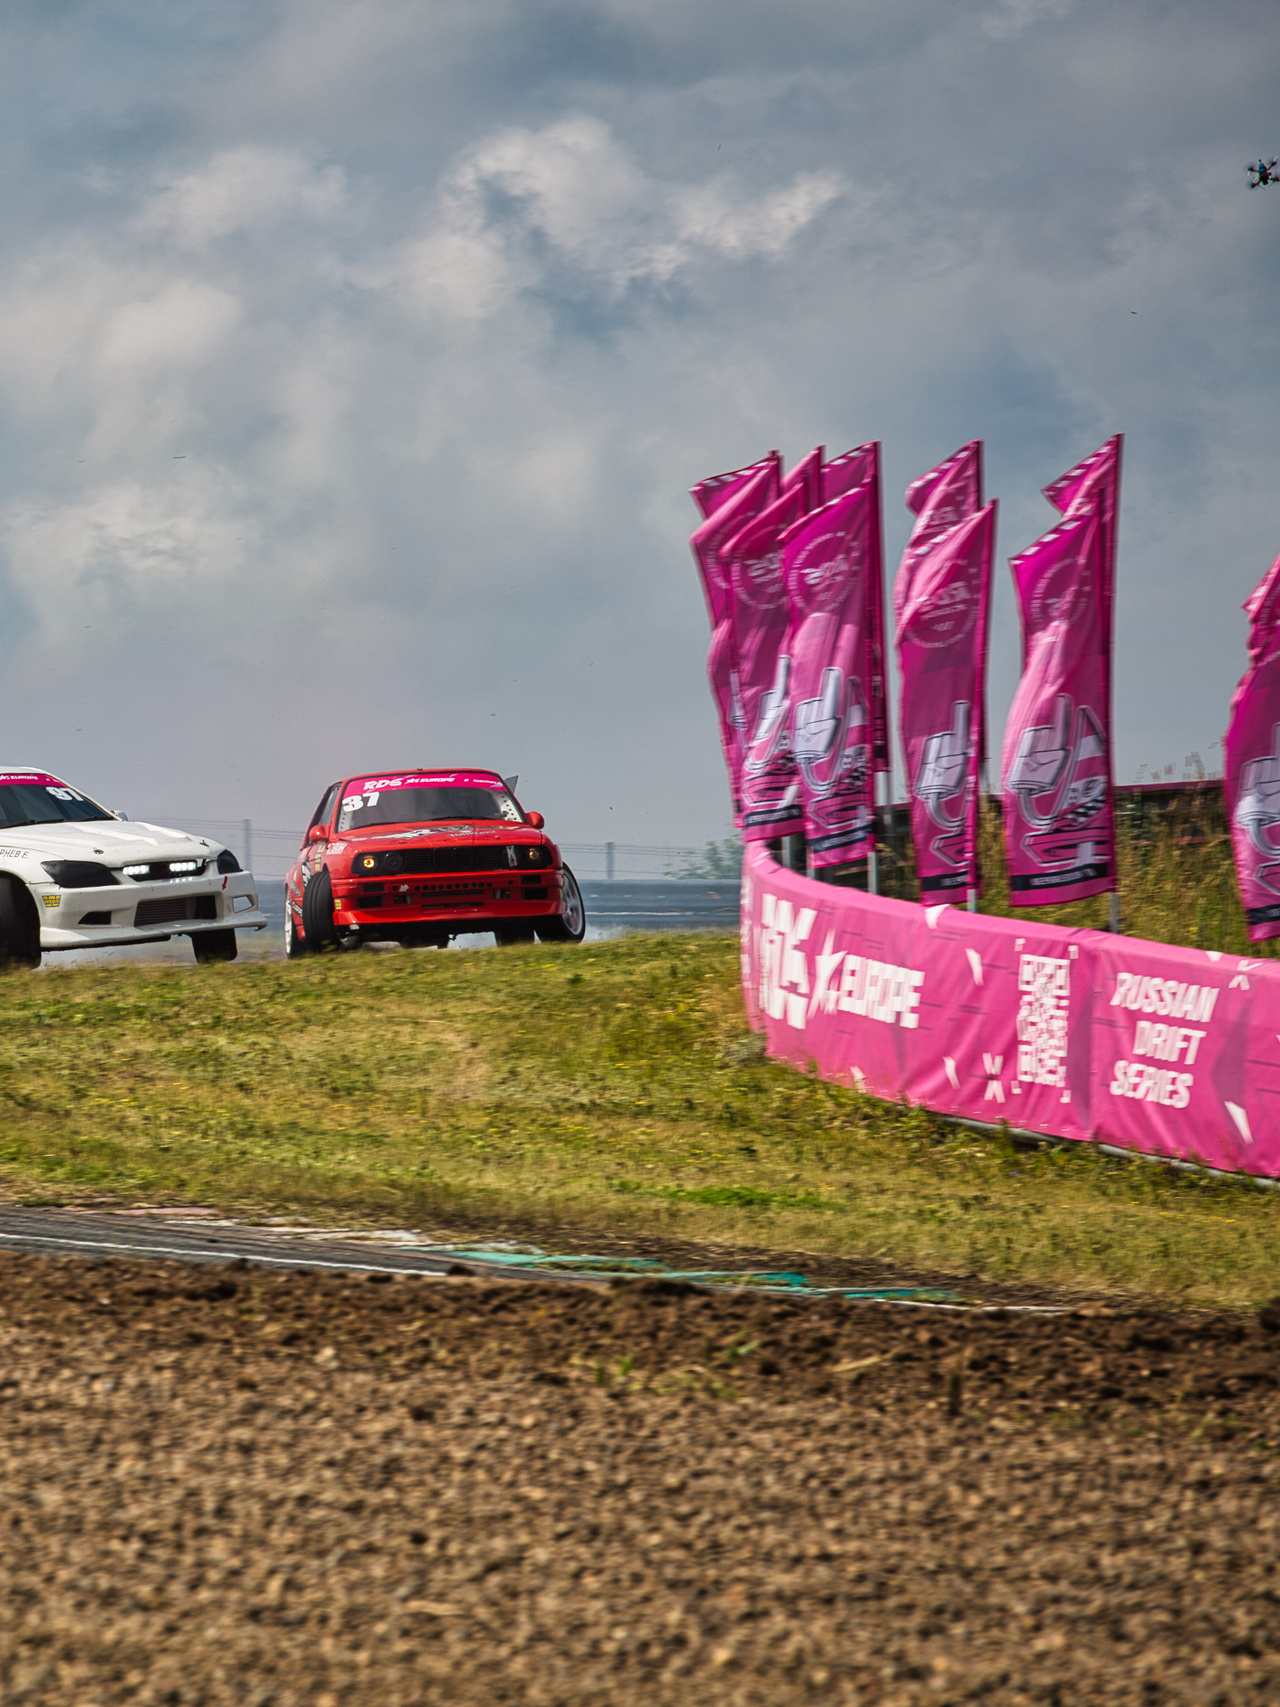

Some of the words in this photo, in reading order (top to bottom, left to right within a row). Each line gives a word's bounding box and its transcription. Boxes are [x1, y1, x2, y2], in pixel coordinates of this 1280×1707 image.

[46, 786, 84, 801] 97
[341, 791, 380, 813] 37
[363, 778, 403, 790] RDS
[837, 954, 926, 1029] EUROPE
[1109, 972, 1220, 1023] RUSSIAN
[1132, 1020, 1207, 1065] DRIFT
[1109, 1060, 1194, 1109] SERIES
